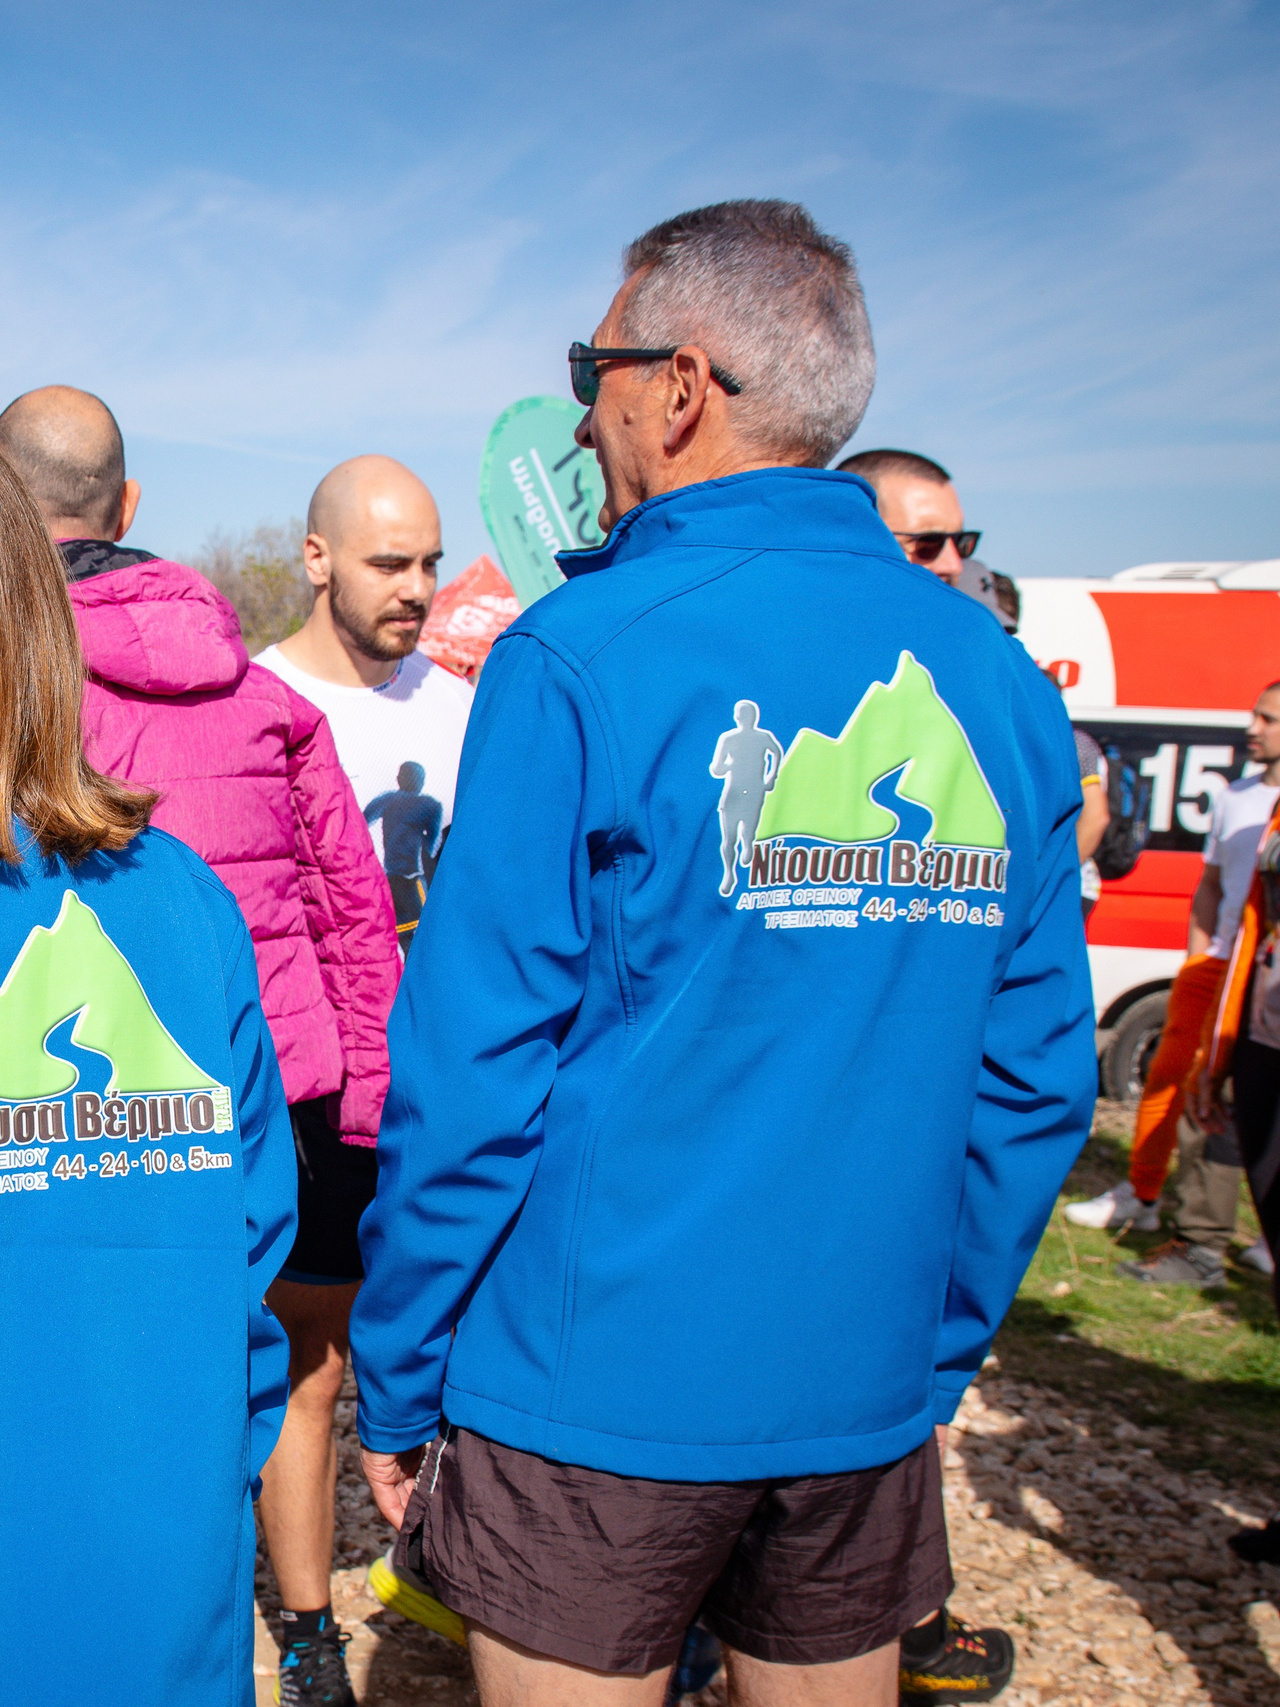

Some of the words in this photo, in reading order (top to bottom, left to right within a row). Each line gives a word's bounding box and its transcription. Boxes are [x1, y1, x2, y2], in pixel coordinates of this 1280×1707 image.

[1140, 743, 1267, 833] 15
[751, 840, 881, 887] Νάουσα
[738, 890, 791, 909] ΑΓΩΝΕΣ
[792, 889, 862, 906] ΟΡΕΙΝΟΥ
[766, 911, 858, 928] ΤΡΕΞΙΜΑΤΟΣ
[77, 1090, 214, 1140] Βέρμιο
[215, 1088, 231, 1132] TRAIL
[190, 1148, 231, 1169] 5km
